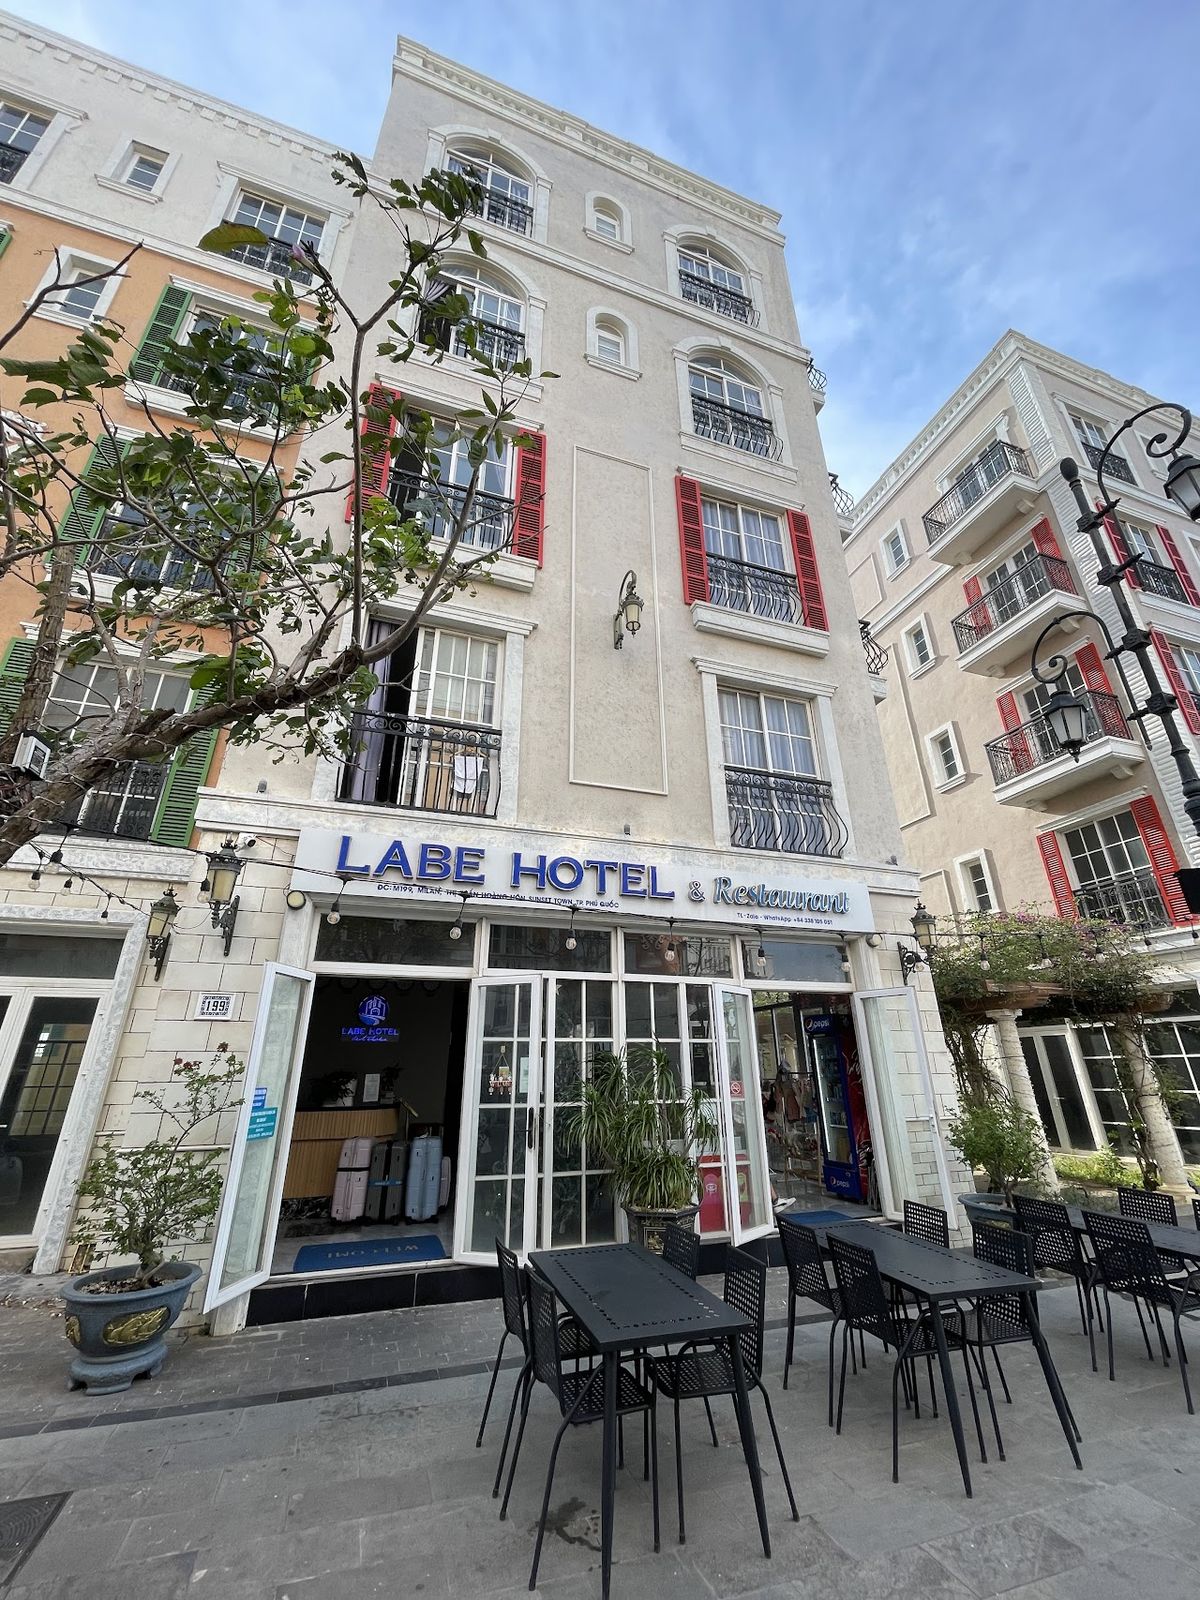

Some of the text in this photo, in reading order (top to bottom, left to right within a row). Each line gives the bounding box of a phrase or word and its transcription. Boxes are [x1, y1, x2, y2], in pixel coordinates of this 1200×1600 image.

[336, 835, 850, 914] LABE HOTEL & Restaurant
[206, 1000, 226, 1011] 199
[813, 1019, 830, 1029] pepsi
[341, 1027, 399, 1036] LABE HOTEL
